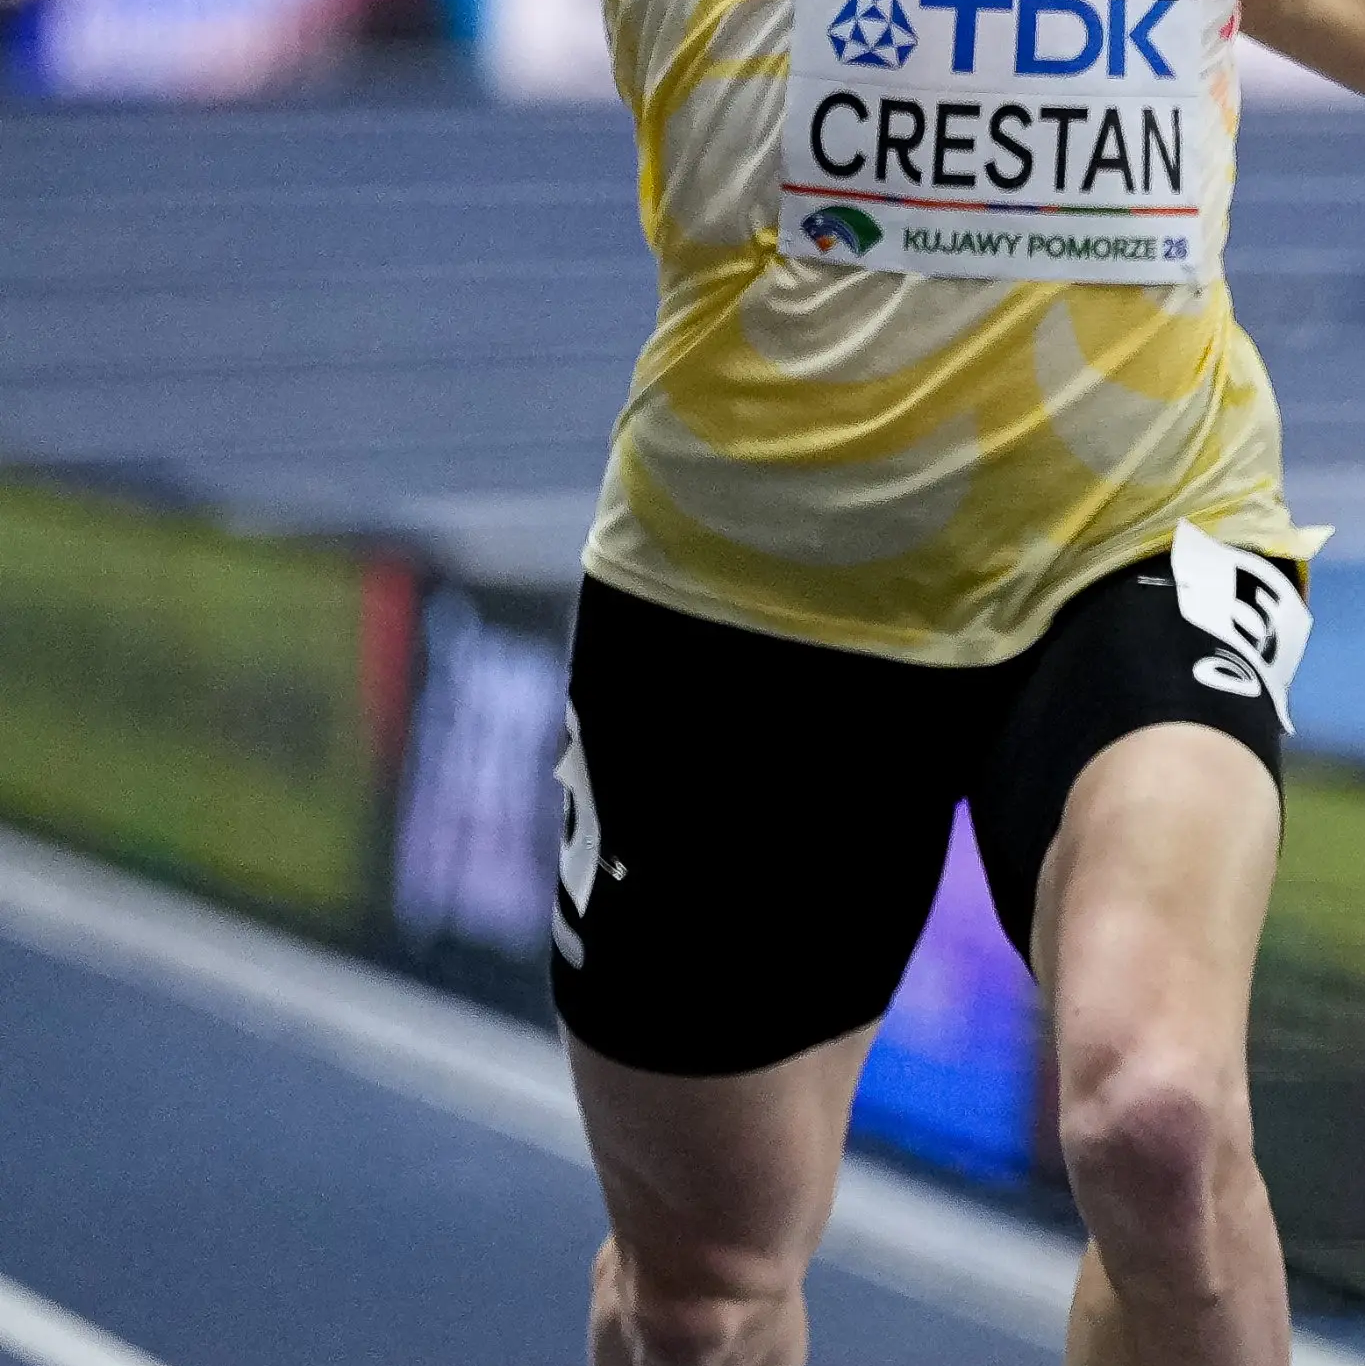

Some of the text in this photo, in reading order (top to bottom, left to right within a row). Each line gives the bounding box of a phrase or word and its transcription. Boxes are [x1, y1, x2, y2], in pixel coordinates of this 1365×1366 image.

[810, 91, 1182, 195] CRESTAN
[902, 227, 1021, 257] KUJAWY
[1027, 233, 1157, 261] POMORZE
